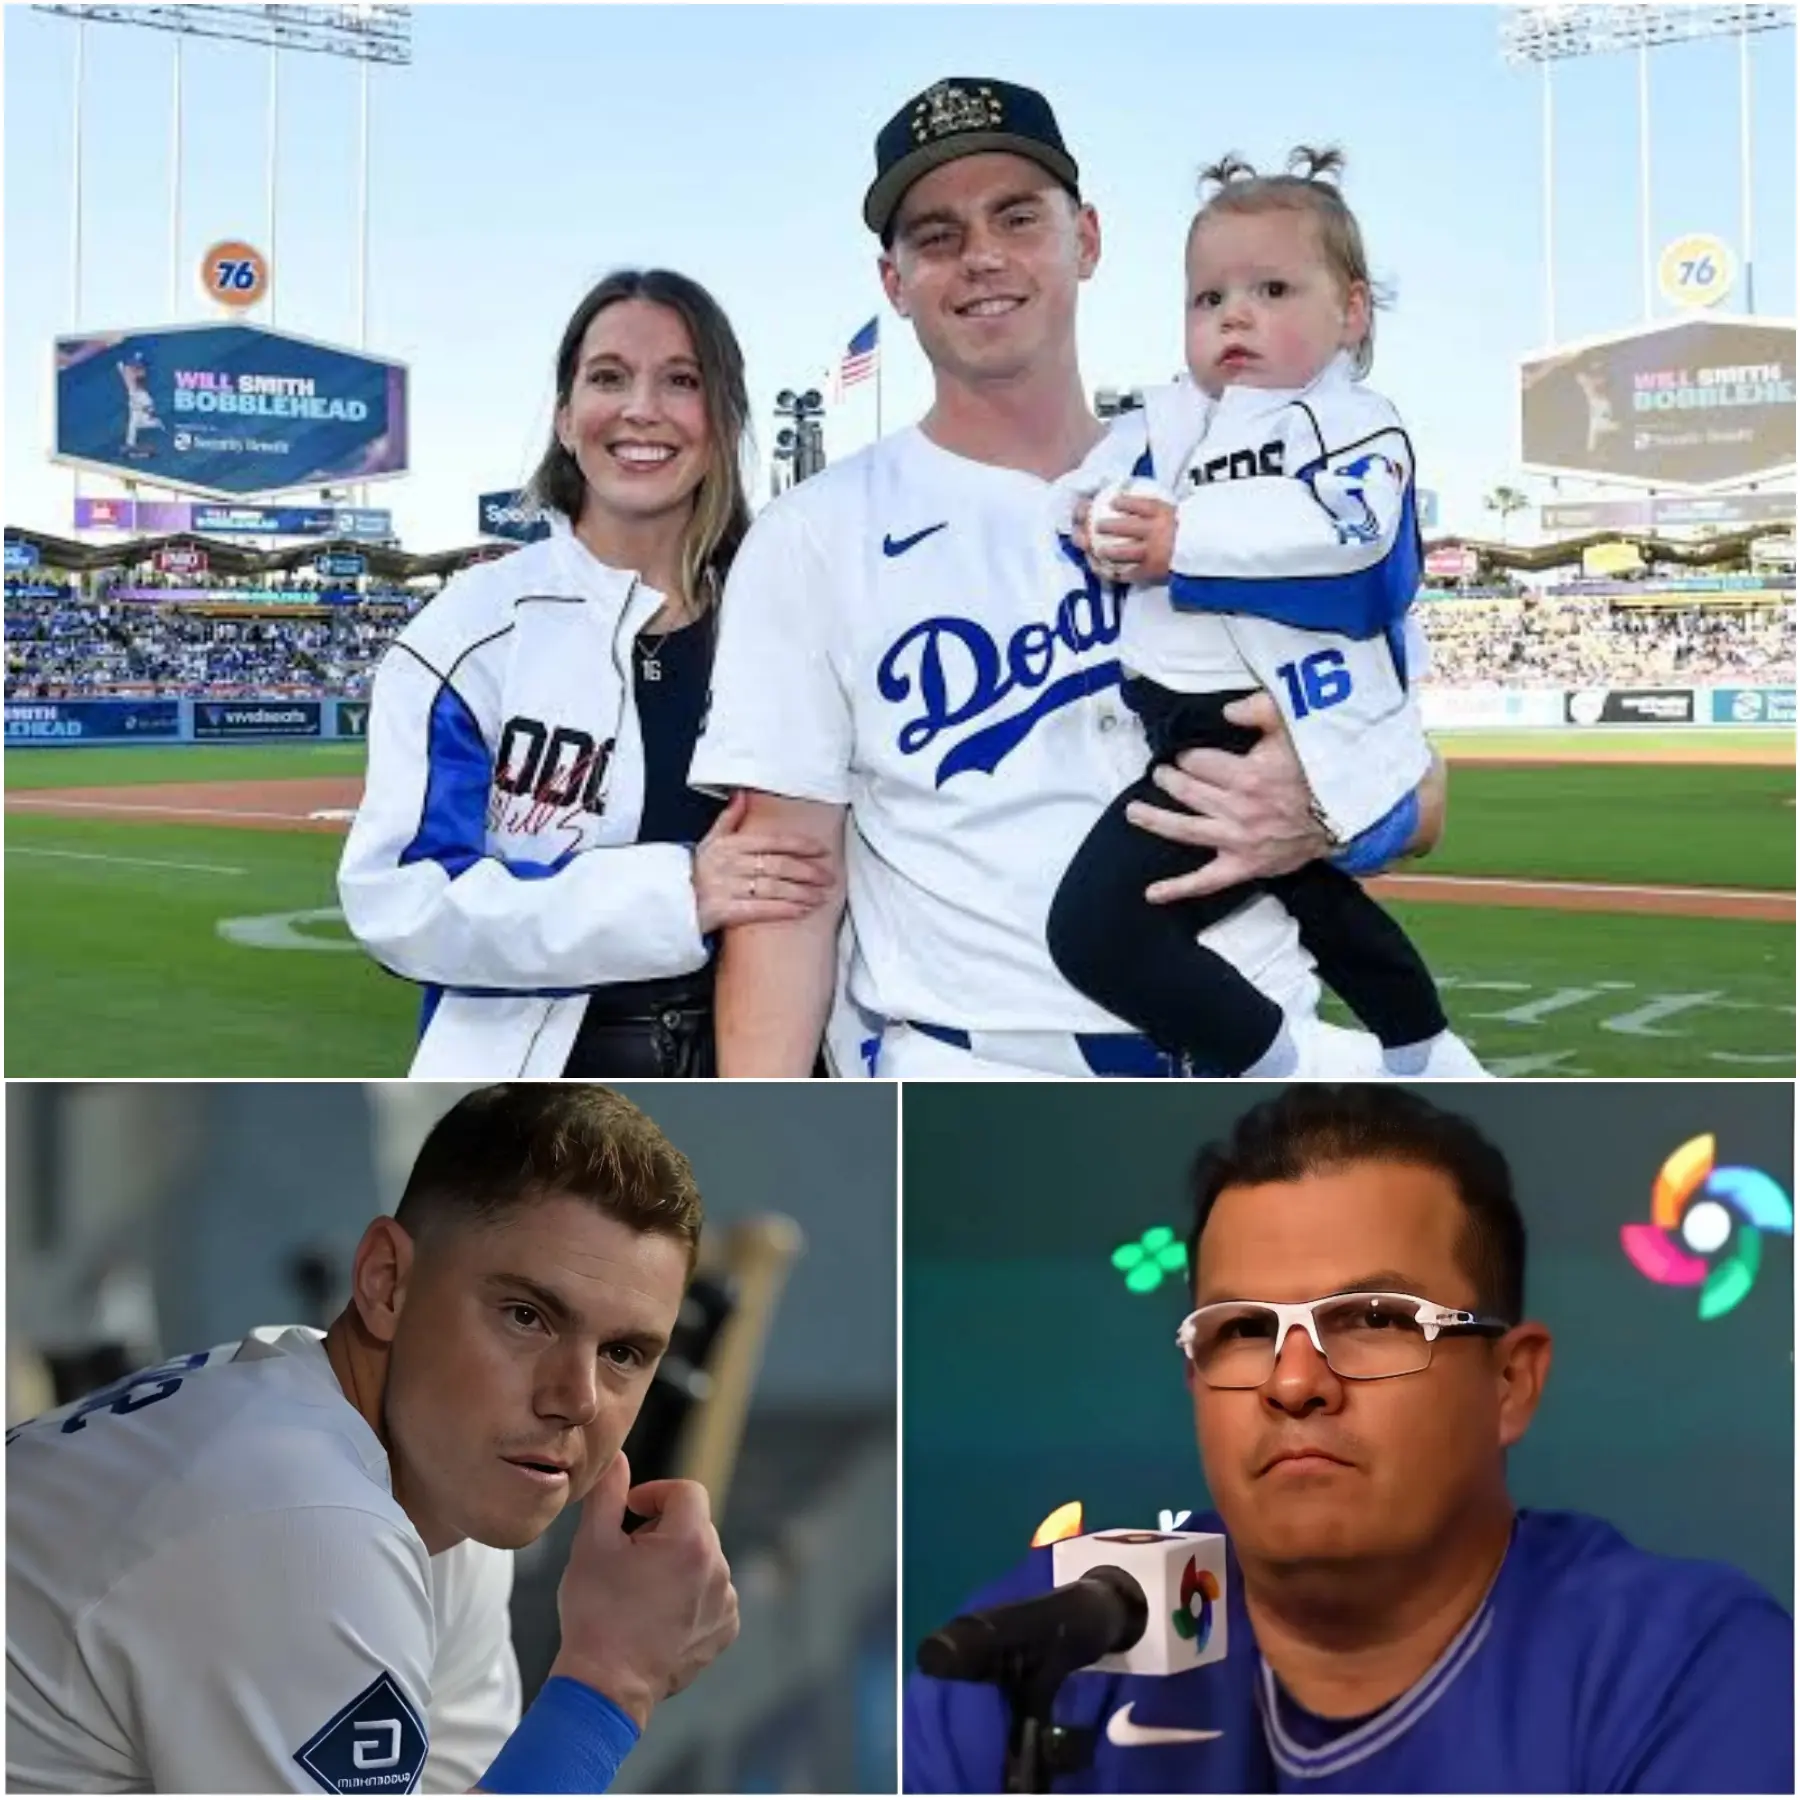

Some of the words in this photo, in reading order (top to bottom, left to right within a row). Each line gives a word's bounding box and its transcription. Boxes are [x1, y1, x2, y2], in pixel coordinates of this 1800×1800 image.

[216, 261, 255, 289] 76
[1678, 257, 1716, 285] 76
[174, 371, 233, 390] WILL
[238, 375, 315, 396] SMITH
[1634, 369, 1689, 390] WILL
[1696, 363, 1782, 387] SMITH
[174, 390, 367, 422] BOBBLEHEAD
[877, 528, 1130, 754] Dod
[642, 660, 661, 681] 16
[1276, 648, 1353, 720] 16
